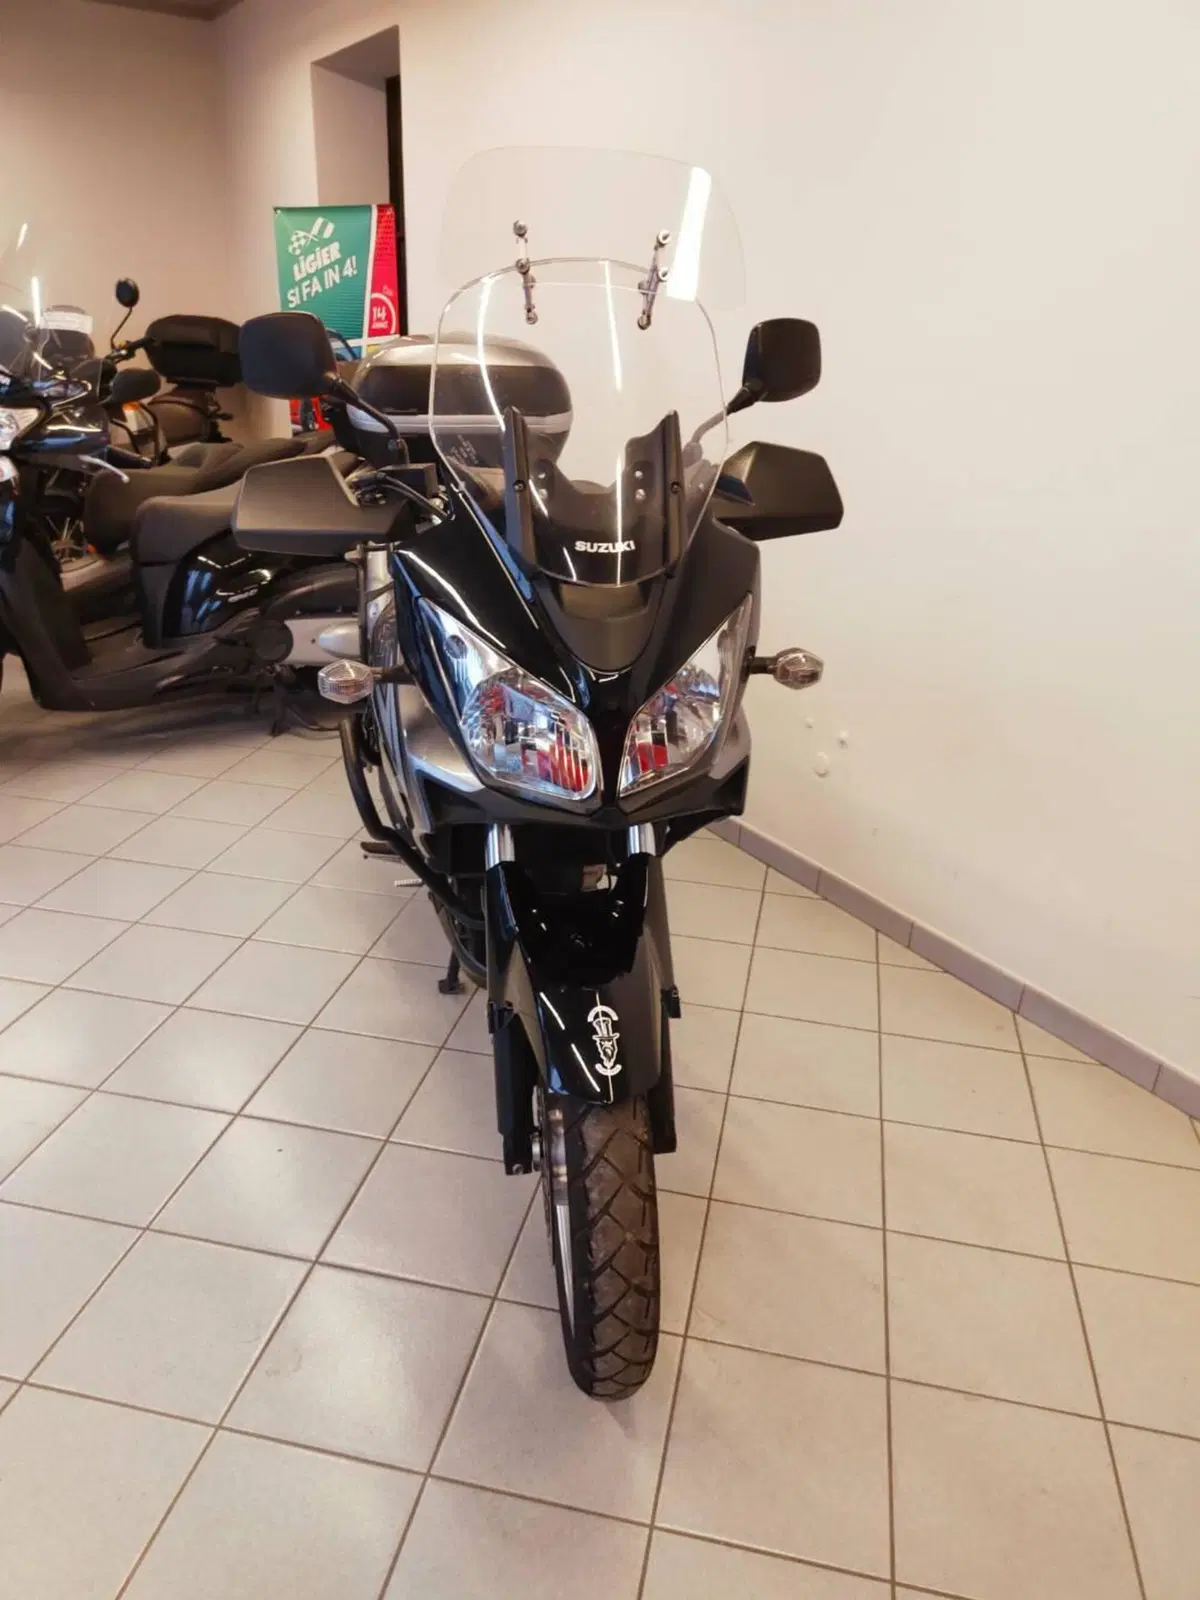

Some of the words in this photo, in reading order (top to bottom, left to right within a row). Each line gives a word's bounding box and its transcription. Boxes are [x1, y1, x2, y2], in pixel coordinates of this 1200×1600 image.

[287, 287, 300, 308] SI
[302, 276, 322, 301] FA
[324, 264, 340, 289] IN
[342, 255, 358, 277] 4!
[372, 305, 387, 321] 14
[574, 540, 636, 553] SUZUKI
